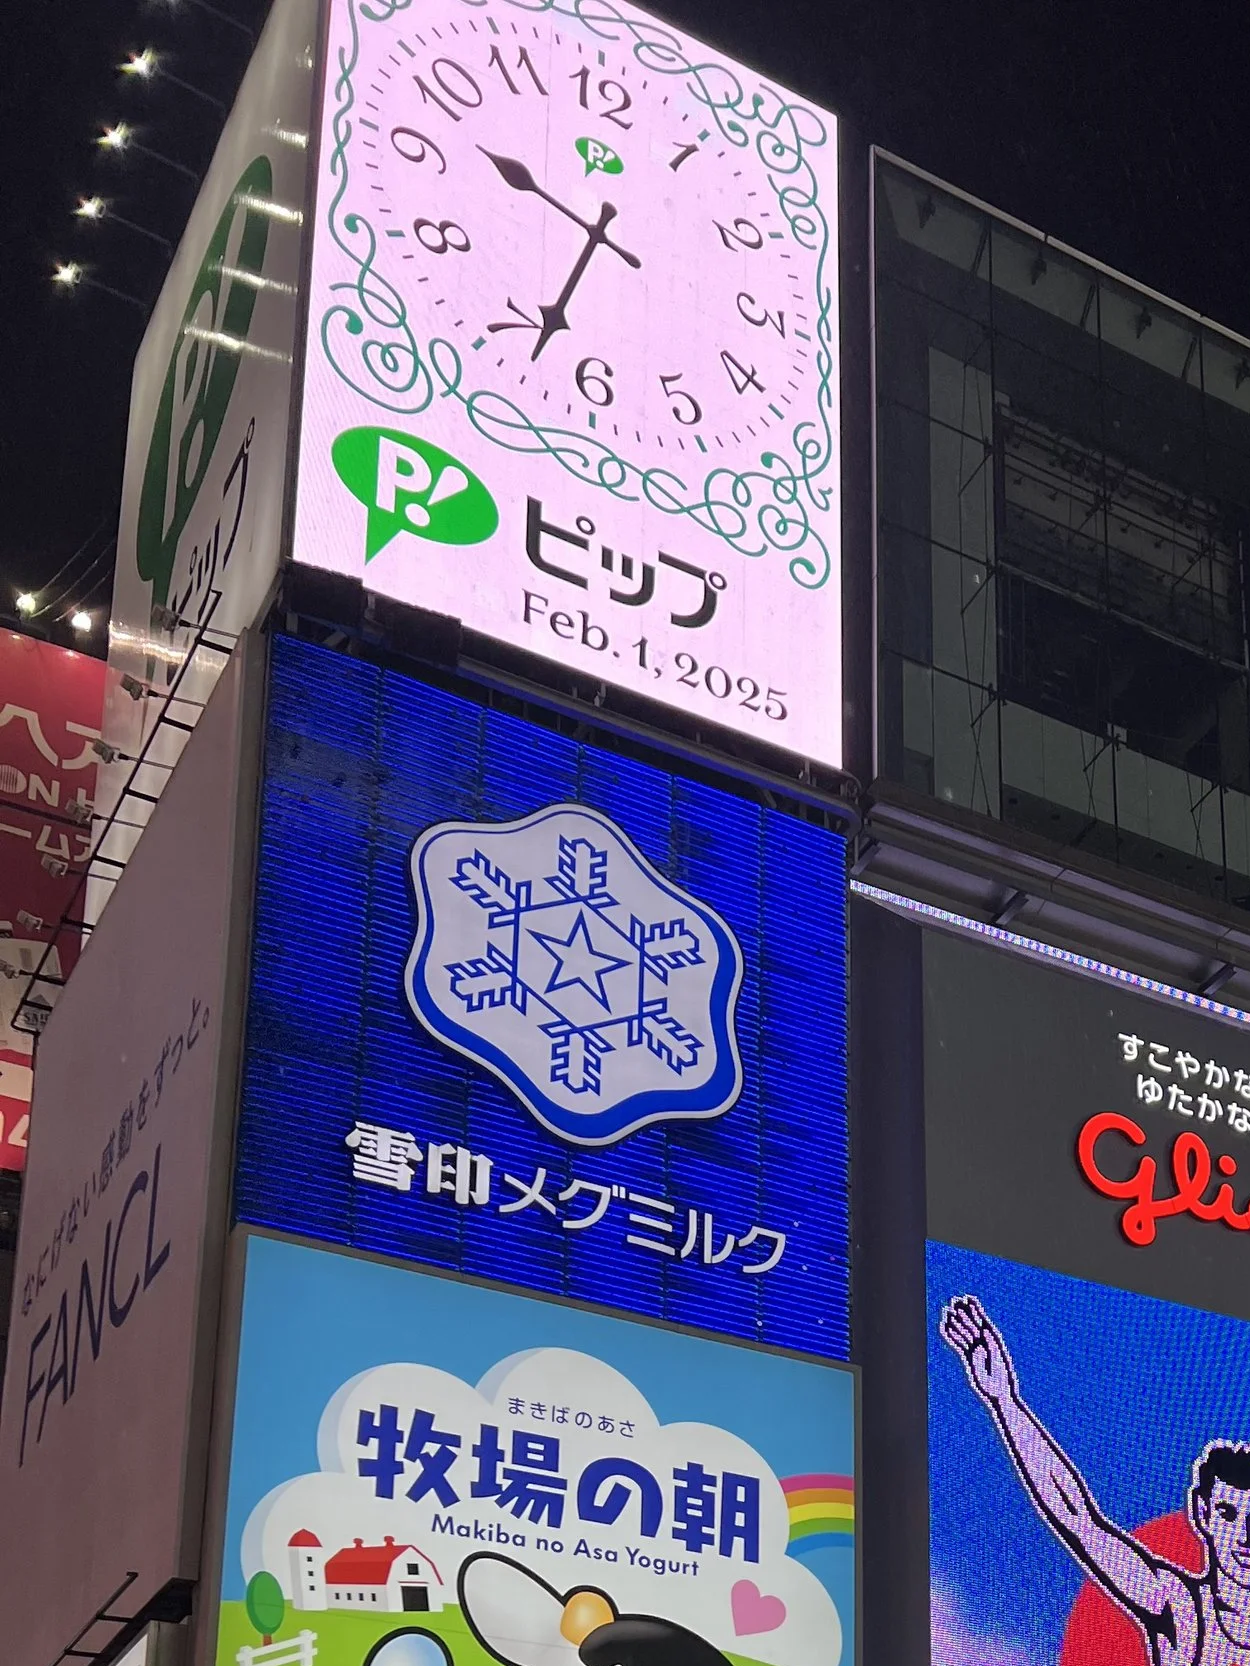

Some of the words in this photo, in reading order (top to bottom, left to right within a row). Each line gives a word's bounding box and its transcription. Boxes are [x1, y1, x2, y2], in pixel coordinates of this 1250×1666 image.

[412, 57, 484, 122] 10
[489, 44, 549, 96] 11
[569, 65, 634, 131] 12
[390, 125, 448, 175] 9
[668, 140, 700, 172] 1
[412, 216, 472, 255] 8
[711, 217, 764, 252] 2
[736, 290, 786, 340] 3
[575, 356, 615, 408] 6
[719, 349, 767, 395] 4
[659, 372, 703, 426] 5
[524, 493, 728, 629] ピップ
[521, 587, 621, 659] Feb.
[631, 636, 664, 681] 1,
[673, 650, 790, 724] 2025
[344, 1120, 787, 1274] 雪印メグミルク
[18, 1140, 172, 1468] FANCL
[507, 1396, 637, 1438] まきばのあさ
[355, 1403, 761, 1565] 牧場の朝
[431, 1513, 526, 1548] Makiba
[536, 1535, 565, 1554] no
[572, 1538, 620, 1565] Asa
[624, 1546, 701, 1577] Yogurt
